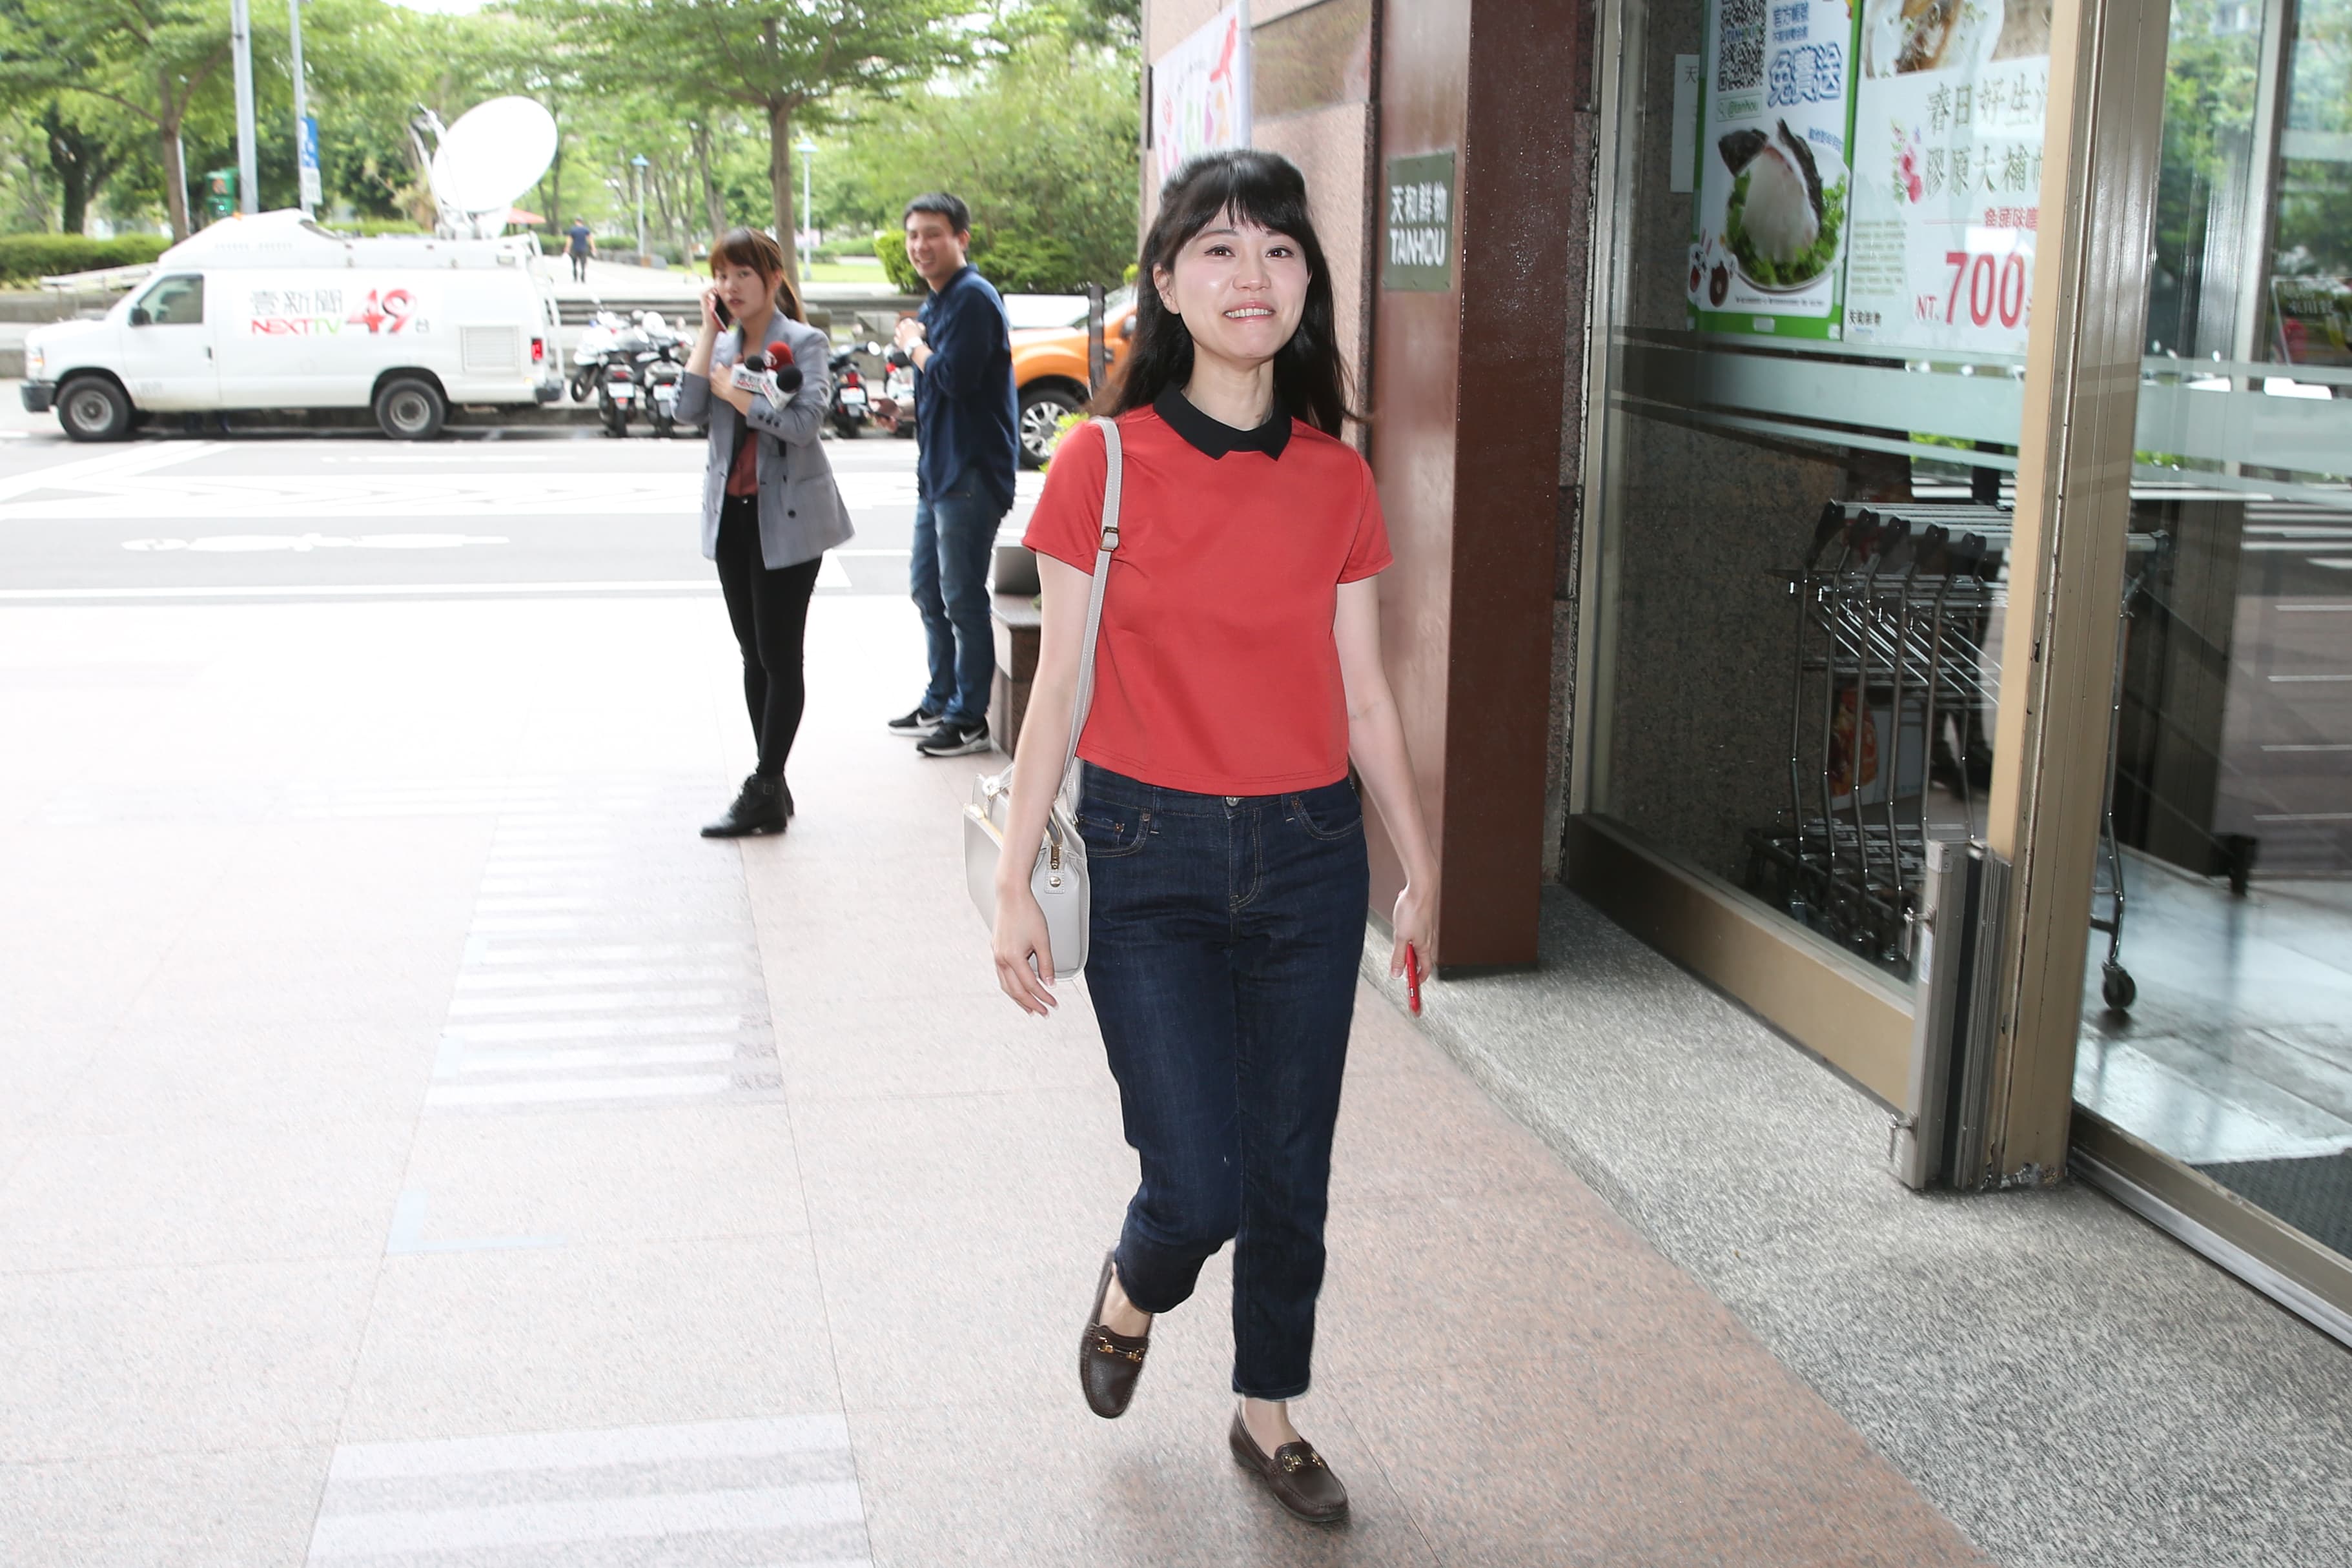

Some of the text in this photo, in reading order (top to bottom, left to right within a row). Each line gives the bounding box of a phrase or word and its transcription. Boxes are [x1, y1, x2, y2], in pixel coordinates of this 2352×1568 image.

[1768, 42, 1842, 108] 免費送
[1389, 227, 1446, 267] TANHOU
[345, 288, 417, 334] 49
[1946, 250, 2025, 329] 700
